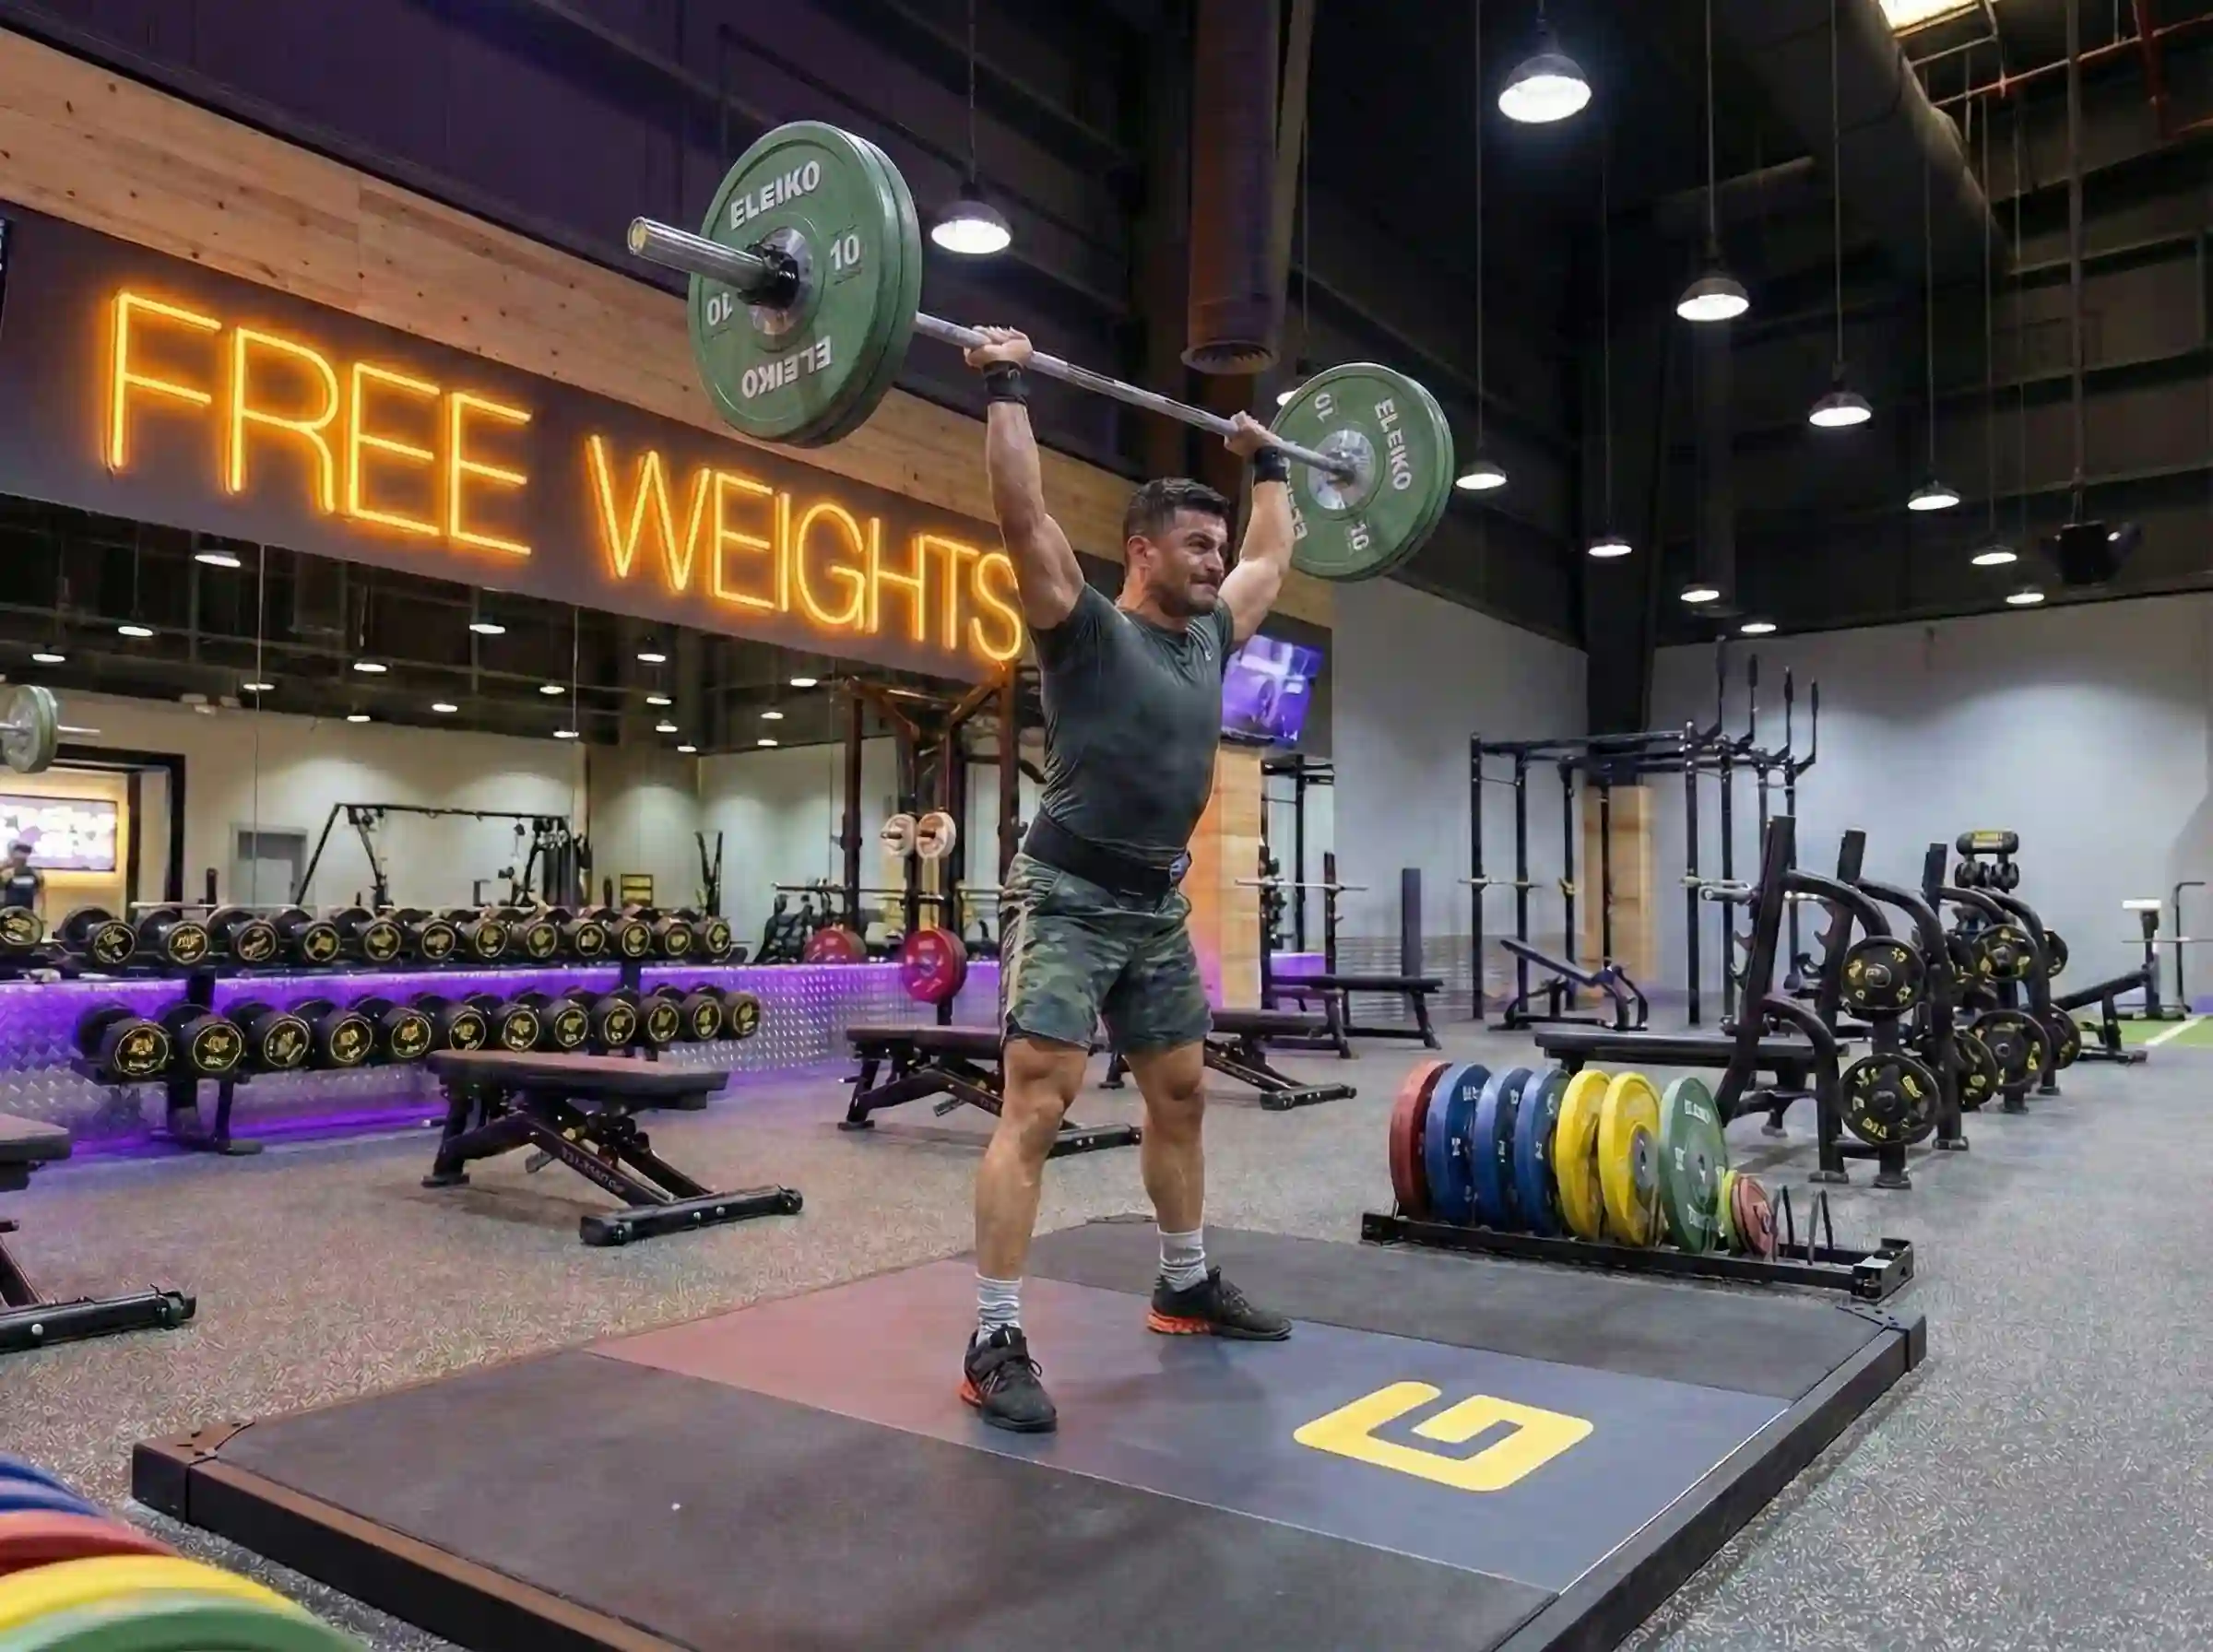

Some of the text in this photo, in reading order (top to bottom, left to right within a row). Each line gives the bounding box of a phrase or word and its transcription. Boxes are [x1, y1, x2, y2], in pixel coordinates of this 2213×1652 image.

[730, 160, 821, 230] ELEIKO
[829, 235, 860, 271] 10
[706, 291, 733, 326] 10
[741, 335, 833, 399] ELEIKO
[1314, 393, 1334, 424] 10
[108, 289, 1023, 661] FREE WEIGHTS
[1373, 396, 1413, 491] ELEIKO
